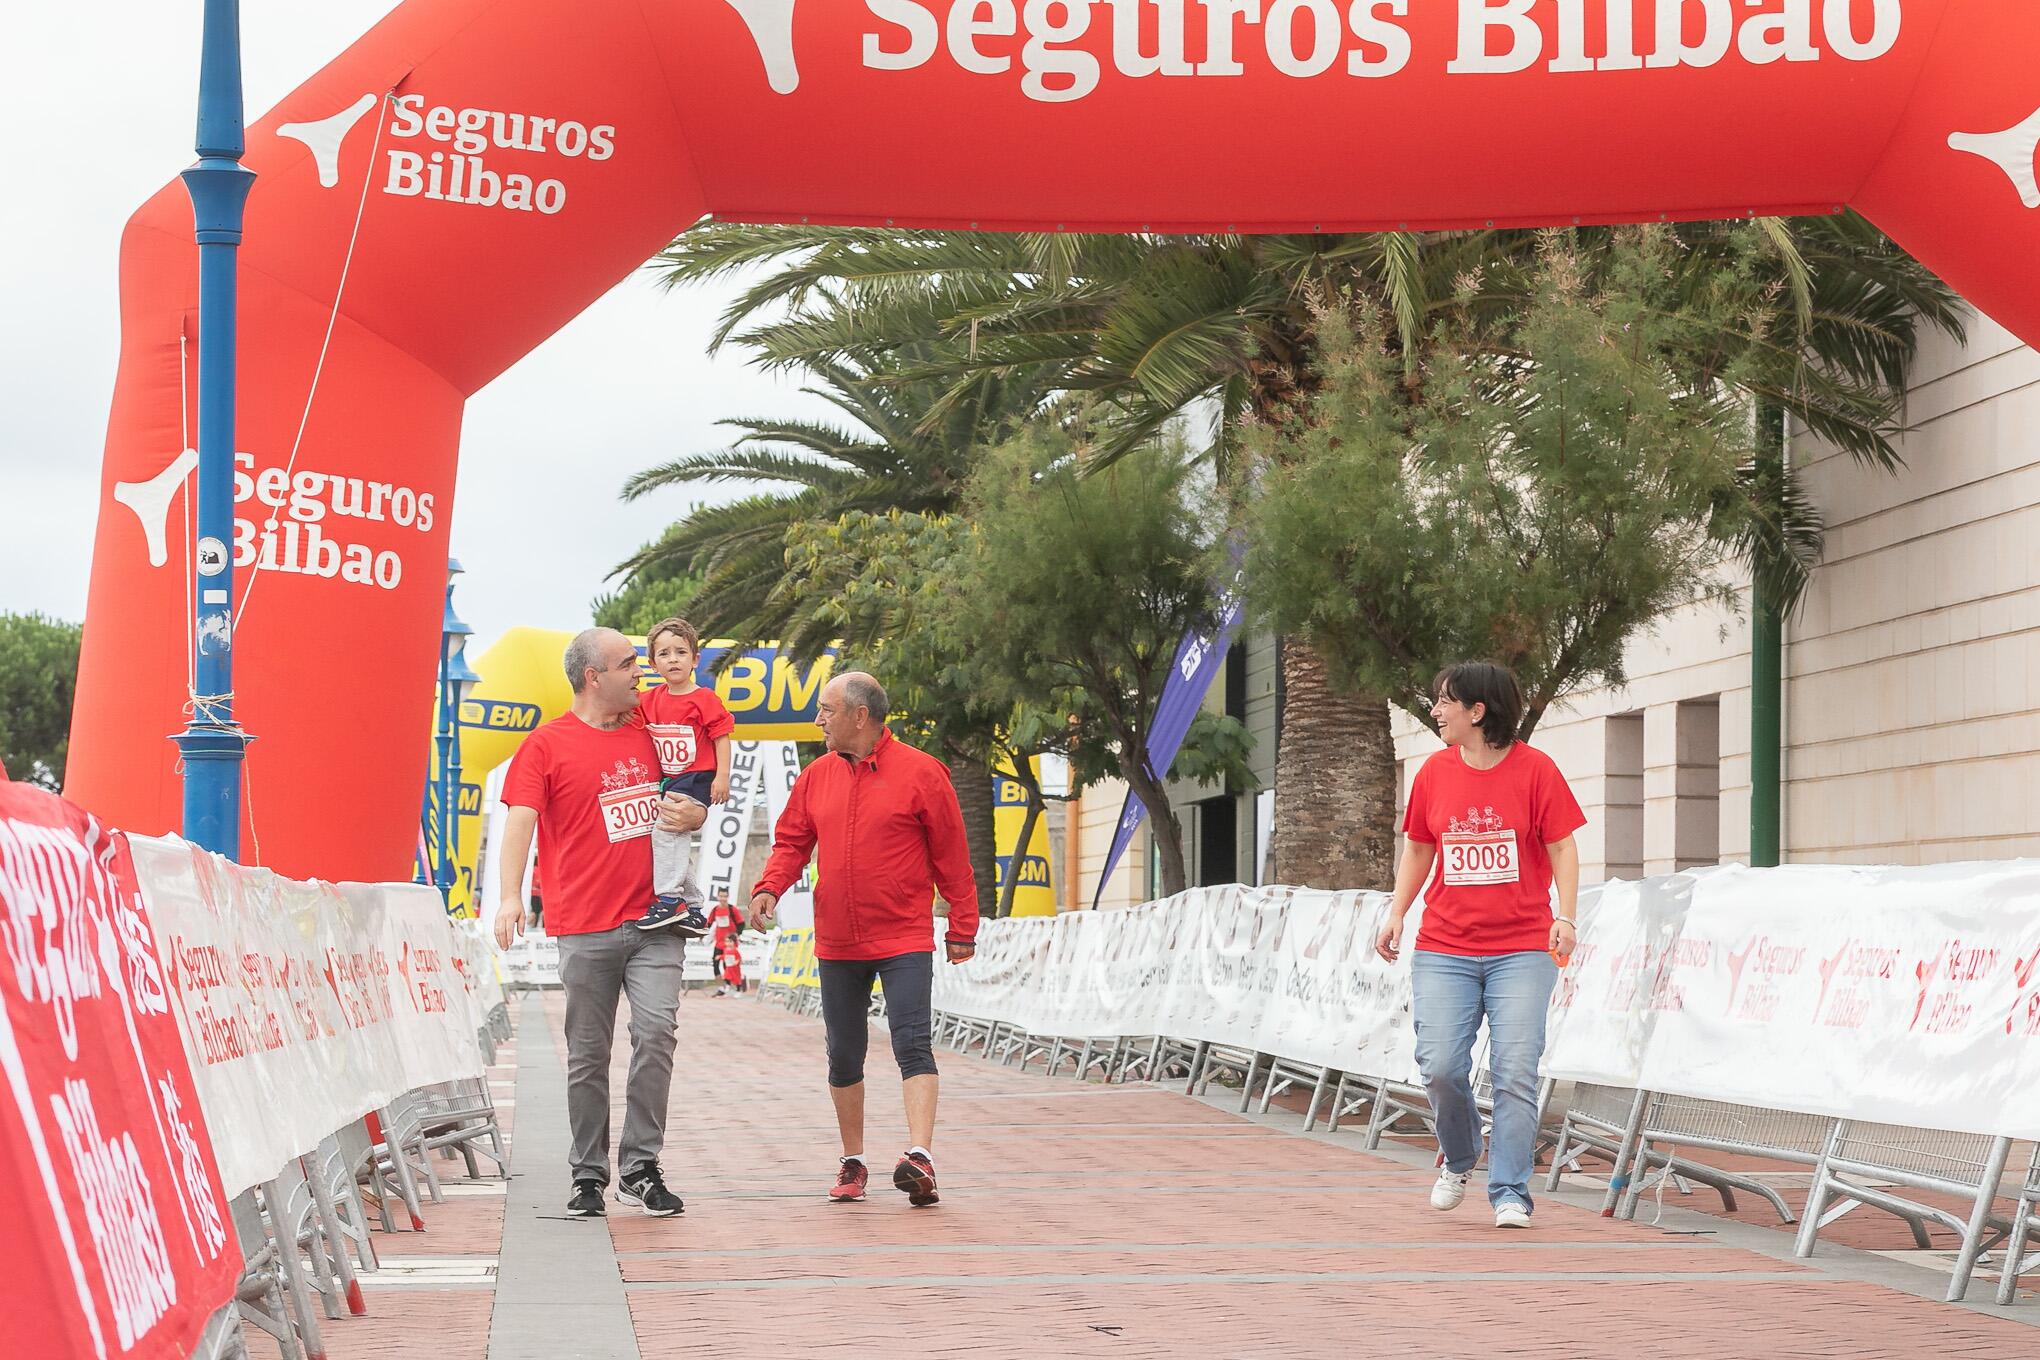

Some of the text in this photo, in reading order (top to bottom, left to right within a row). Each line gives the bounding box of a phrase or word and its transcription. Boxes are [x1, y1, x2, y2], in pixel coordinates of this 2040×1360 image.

[862, 0, 1902, 103] Seguros Bilbao
[389, 92, 616, 162] Seguros
[382, 150, 567, 214] Bilbao
[232, 452, 435, 533] Seguros
[714, 654, 836, 714] BM
[488, 704, 536, 729] BM
[610, 797, 661, 829] 3008
[1451, 843, 1511, 872] 3008
